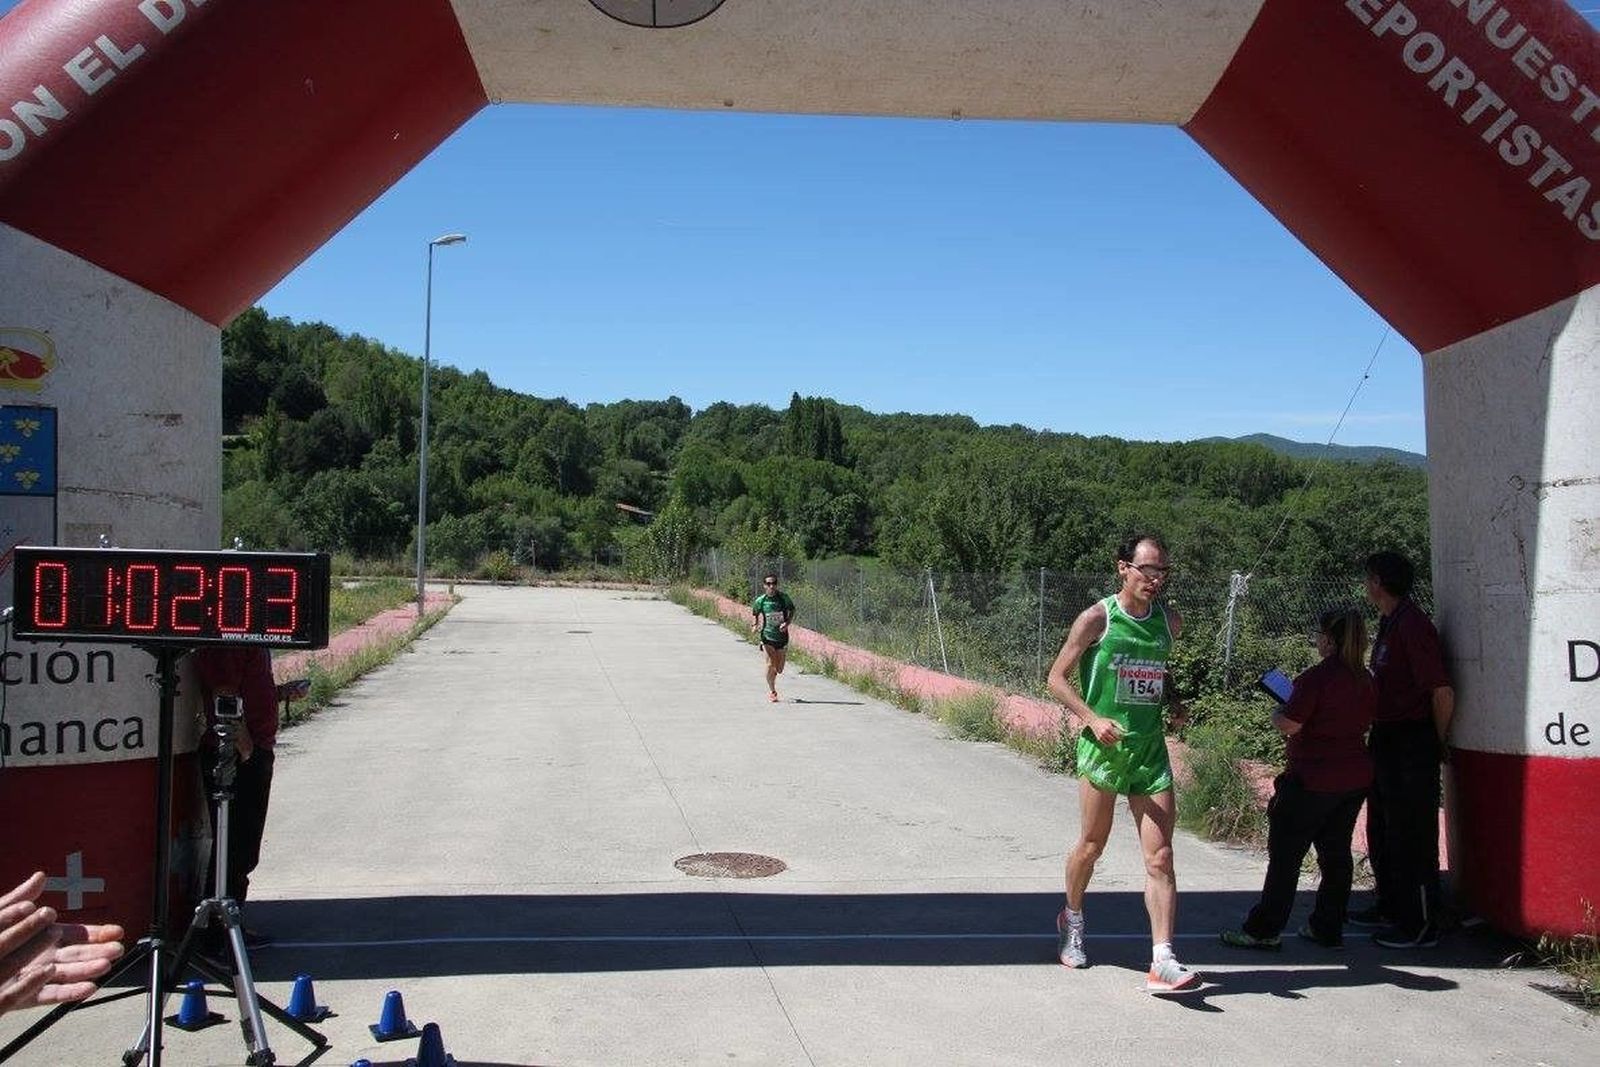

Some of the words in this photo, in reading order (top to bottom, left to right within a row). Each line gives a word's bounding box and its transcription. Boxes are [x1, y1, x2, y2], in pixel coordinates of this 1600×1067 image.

[0, 84, 69, 161] ON
[62, 34, 147, 96] EL
[138, 0, 207, 35] D
[1454, 0, 1600, 143] NUEST
[34, 561, 298, 634] 01:02:03
[0, 641, 115, 686] ción
[1128, 680, 1156, 695] 154
[1545, 712, 1591, 746] de
